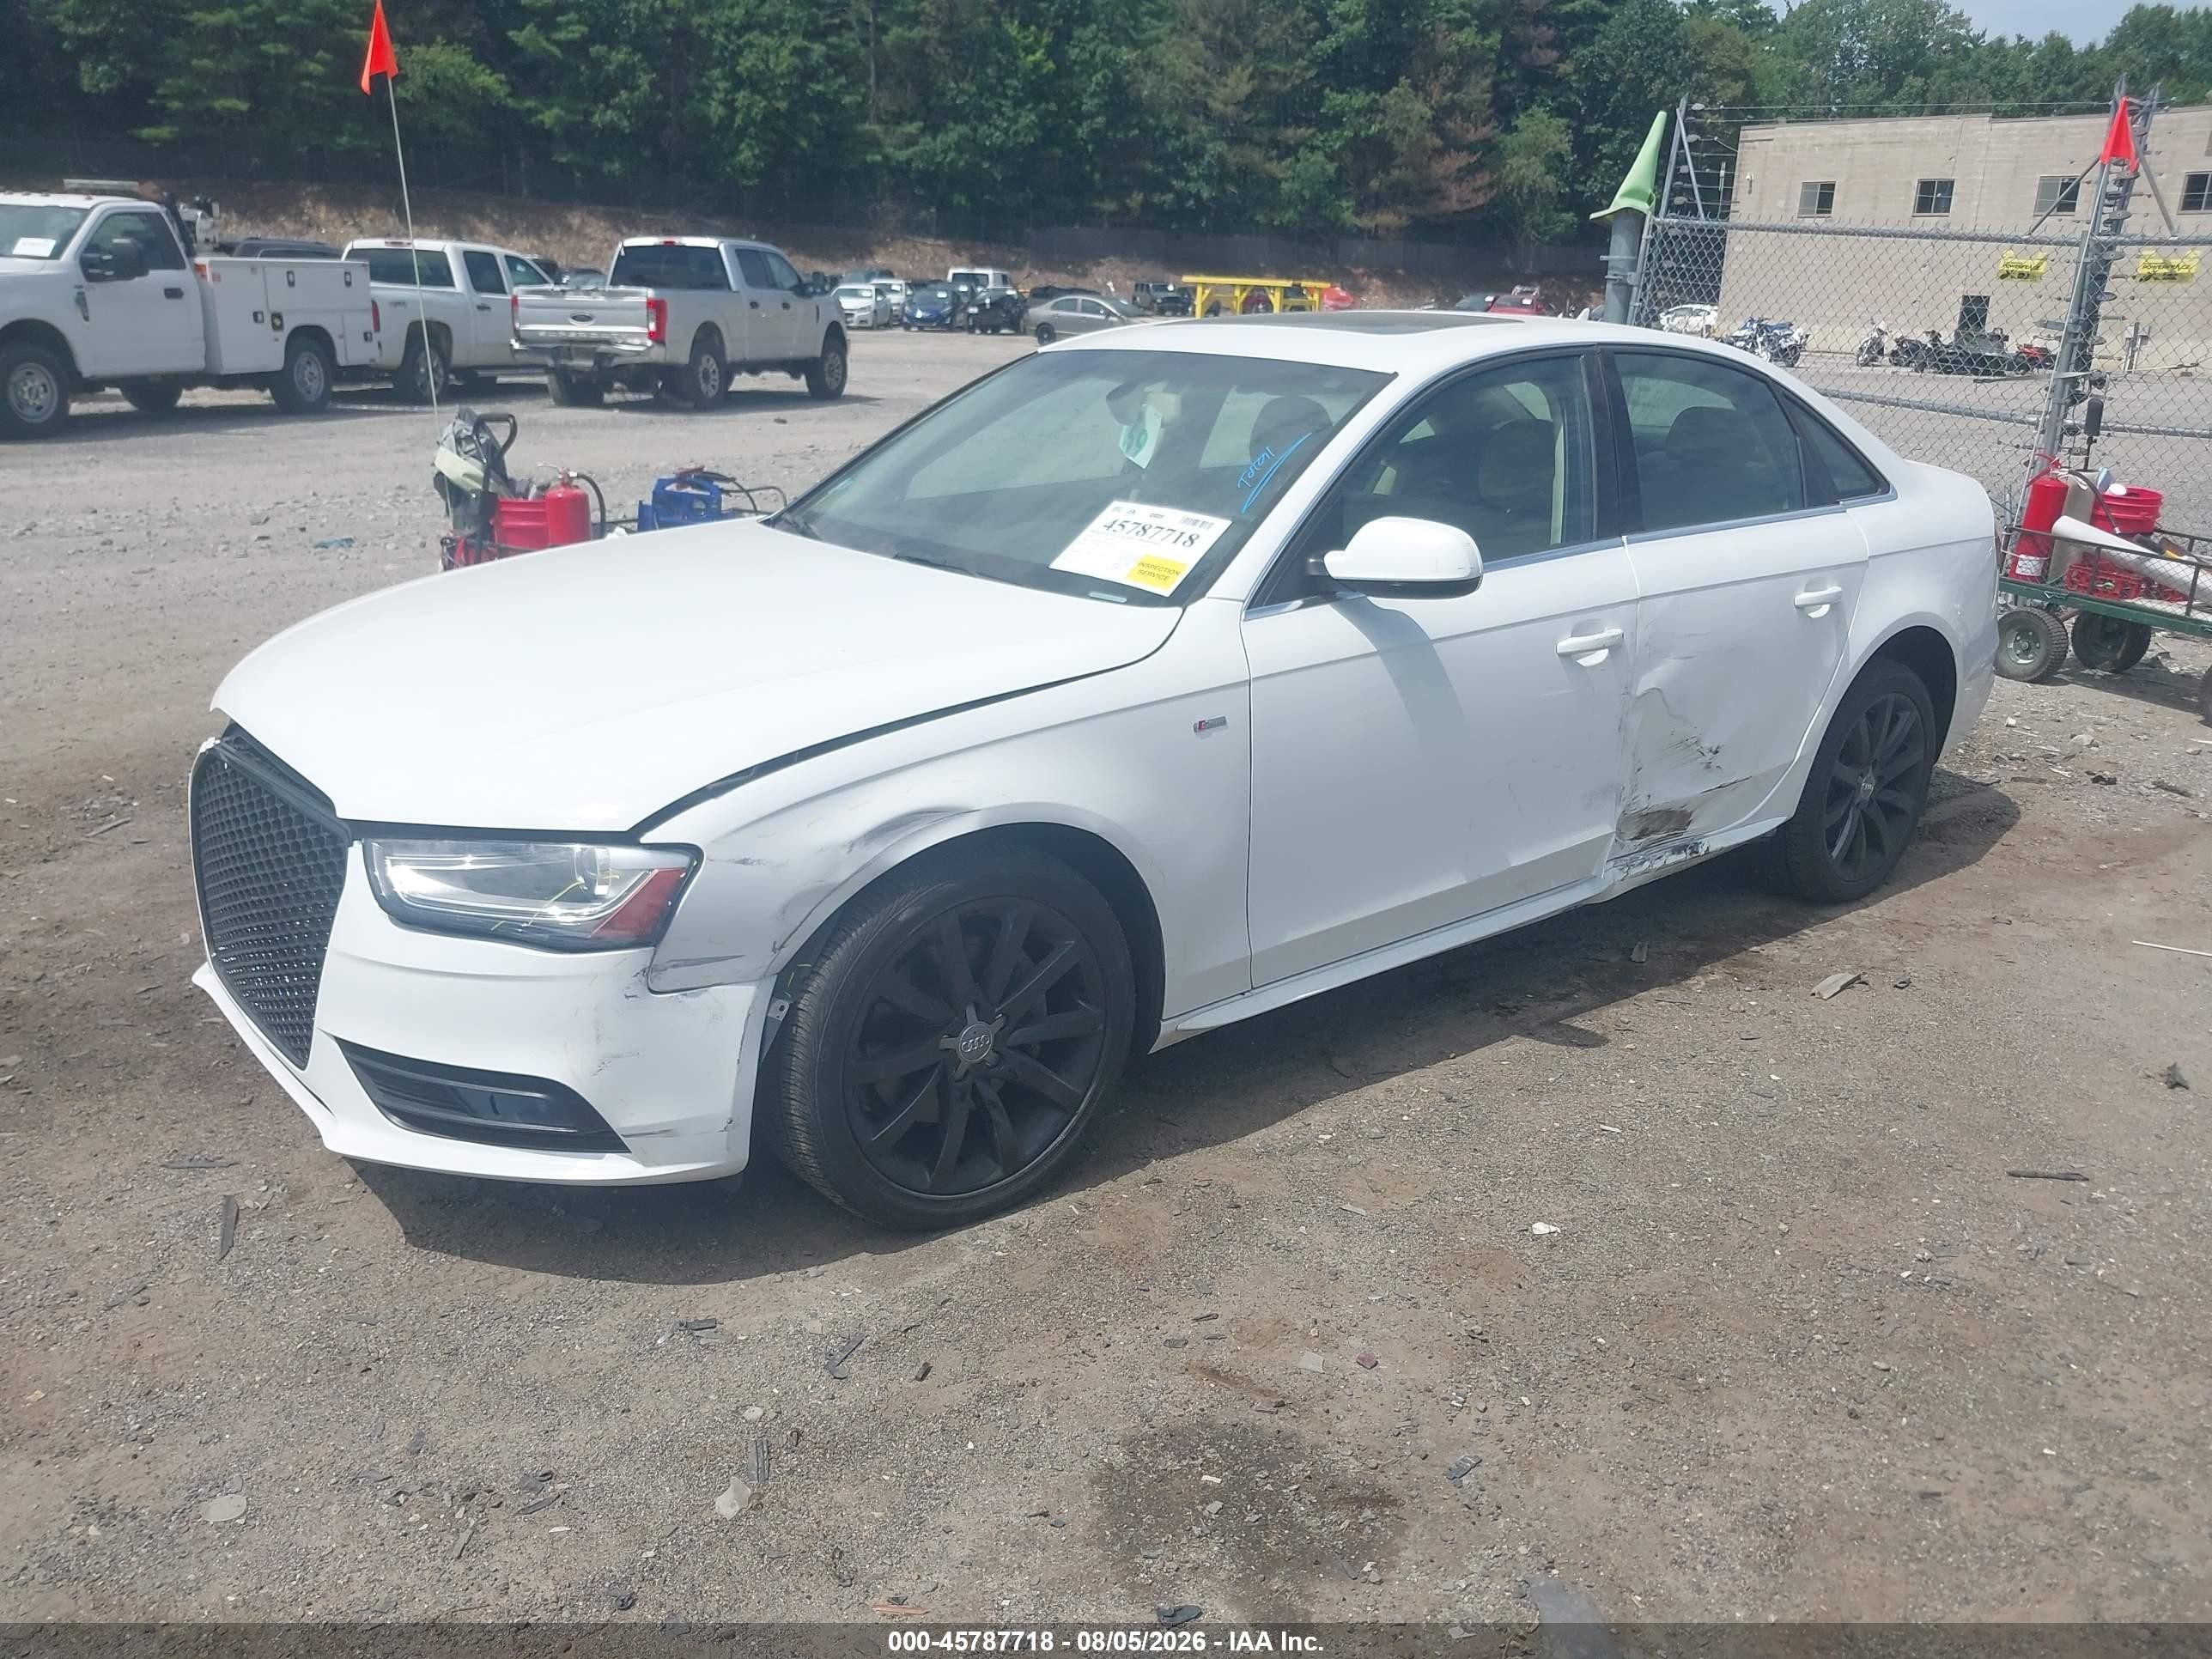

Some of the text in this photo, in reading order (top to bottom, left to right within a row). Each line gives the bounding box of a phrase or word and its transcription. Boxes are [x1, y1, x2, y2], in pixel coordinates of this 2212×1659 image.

[1237, 446, 1275, 489] Total
[1103, 519, 1200, 548] 45787718
[1137, 568, 1170, 581] SERVICE
[1139, 562, 1181, 575] INSPECTION
